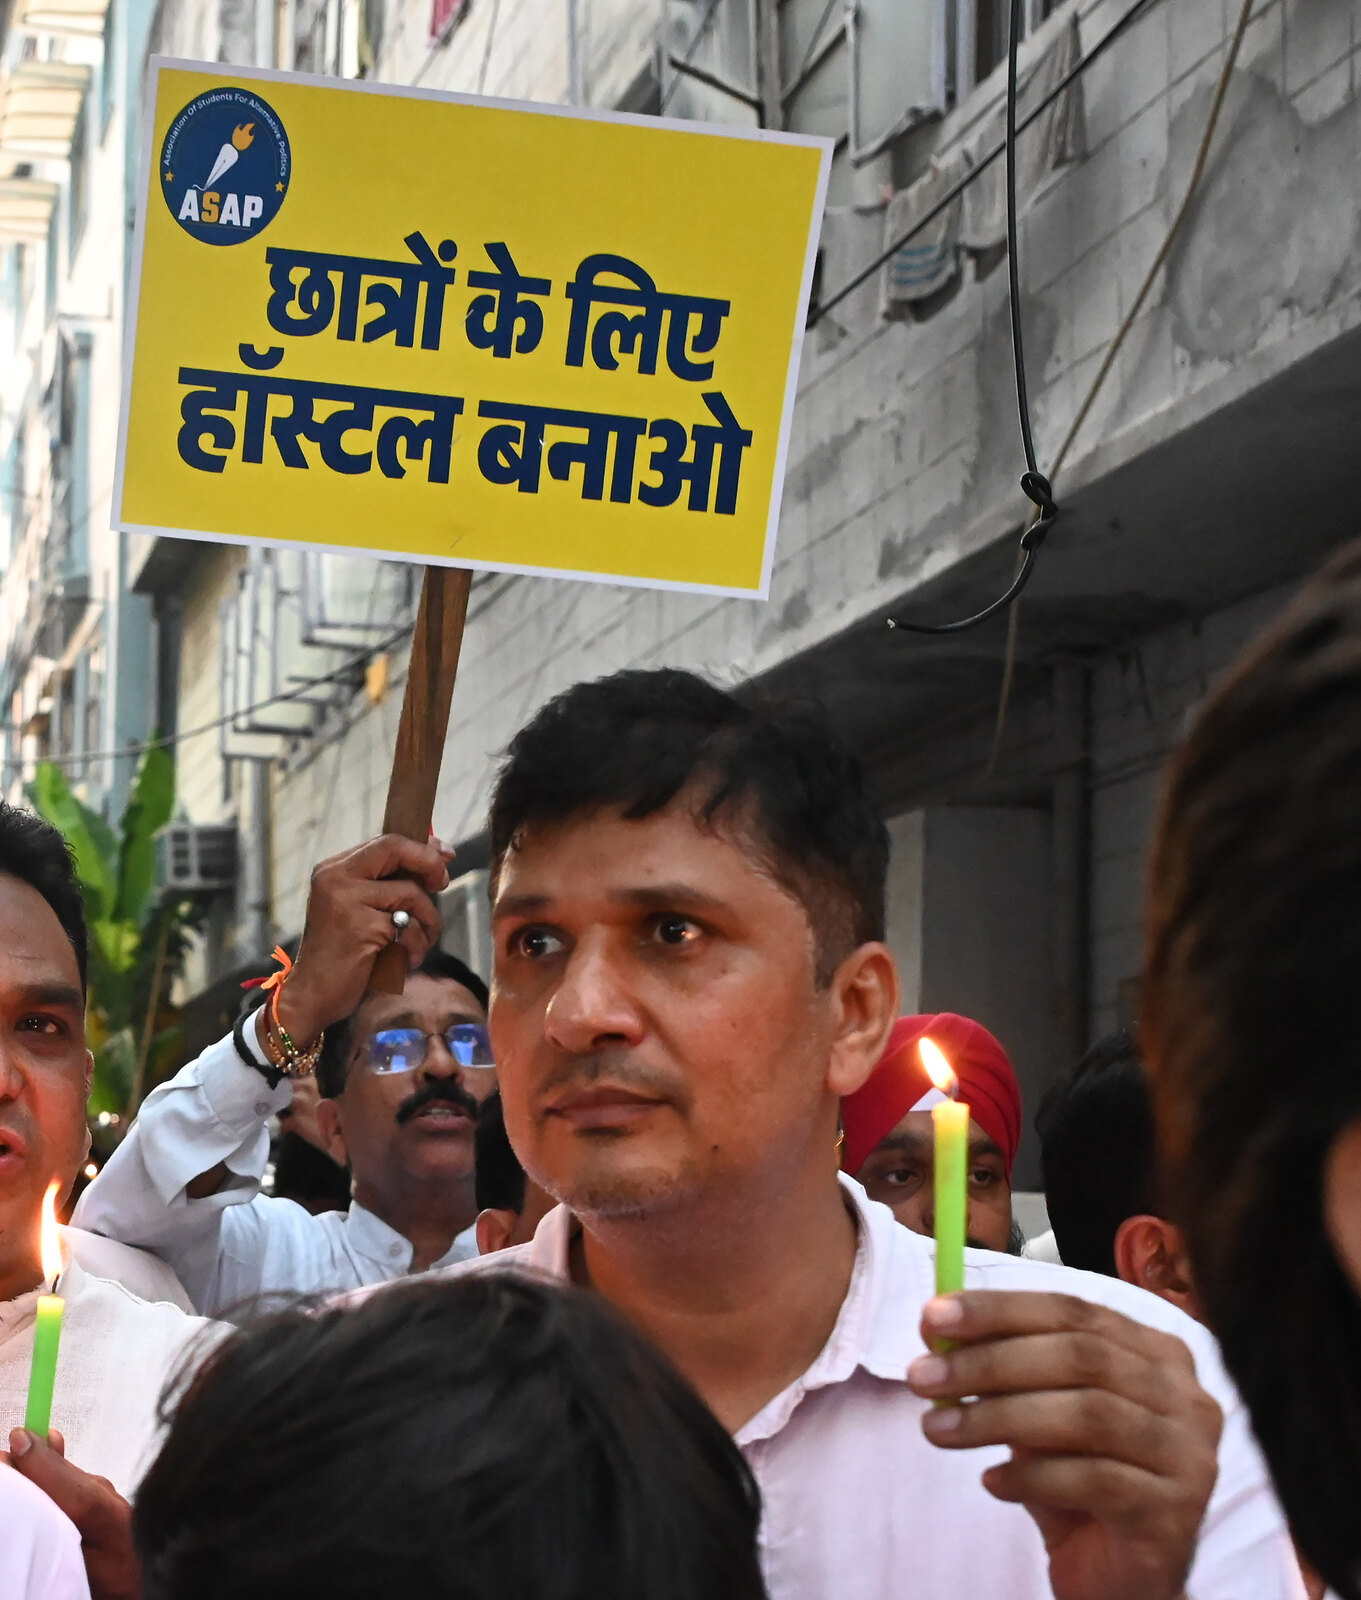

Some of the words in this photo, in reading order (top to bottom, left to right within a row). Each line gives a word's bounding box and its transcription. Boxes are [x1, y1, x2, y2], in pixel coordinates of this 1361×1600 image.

[163, 114, 189, 166] Association
[188, 104, 197, 116] Of
[198, 93, 233, 108] Students
[234, 93, 248, 103] For
[248, 99, 281, 140] Alternative
[277, 140, 286, 177] Politics
[178, 188, 264, 228] ASAP
[265, 230, 456, 352] छात्रों
[465, 241, 551, 359] के
[566, 253, 731, 382] लिए
[177, 343, 464, 485] हॉस्टल
[477, 391, 753, 516] बनाओ
